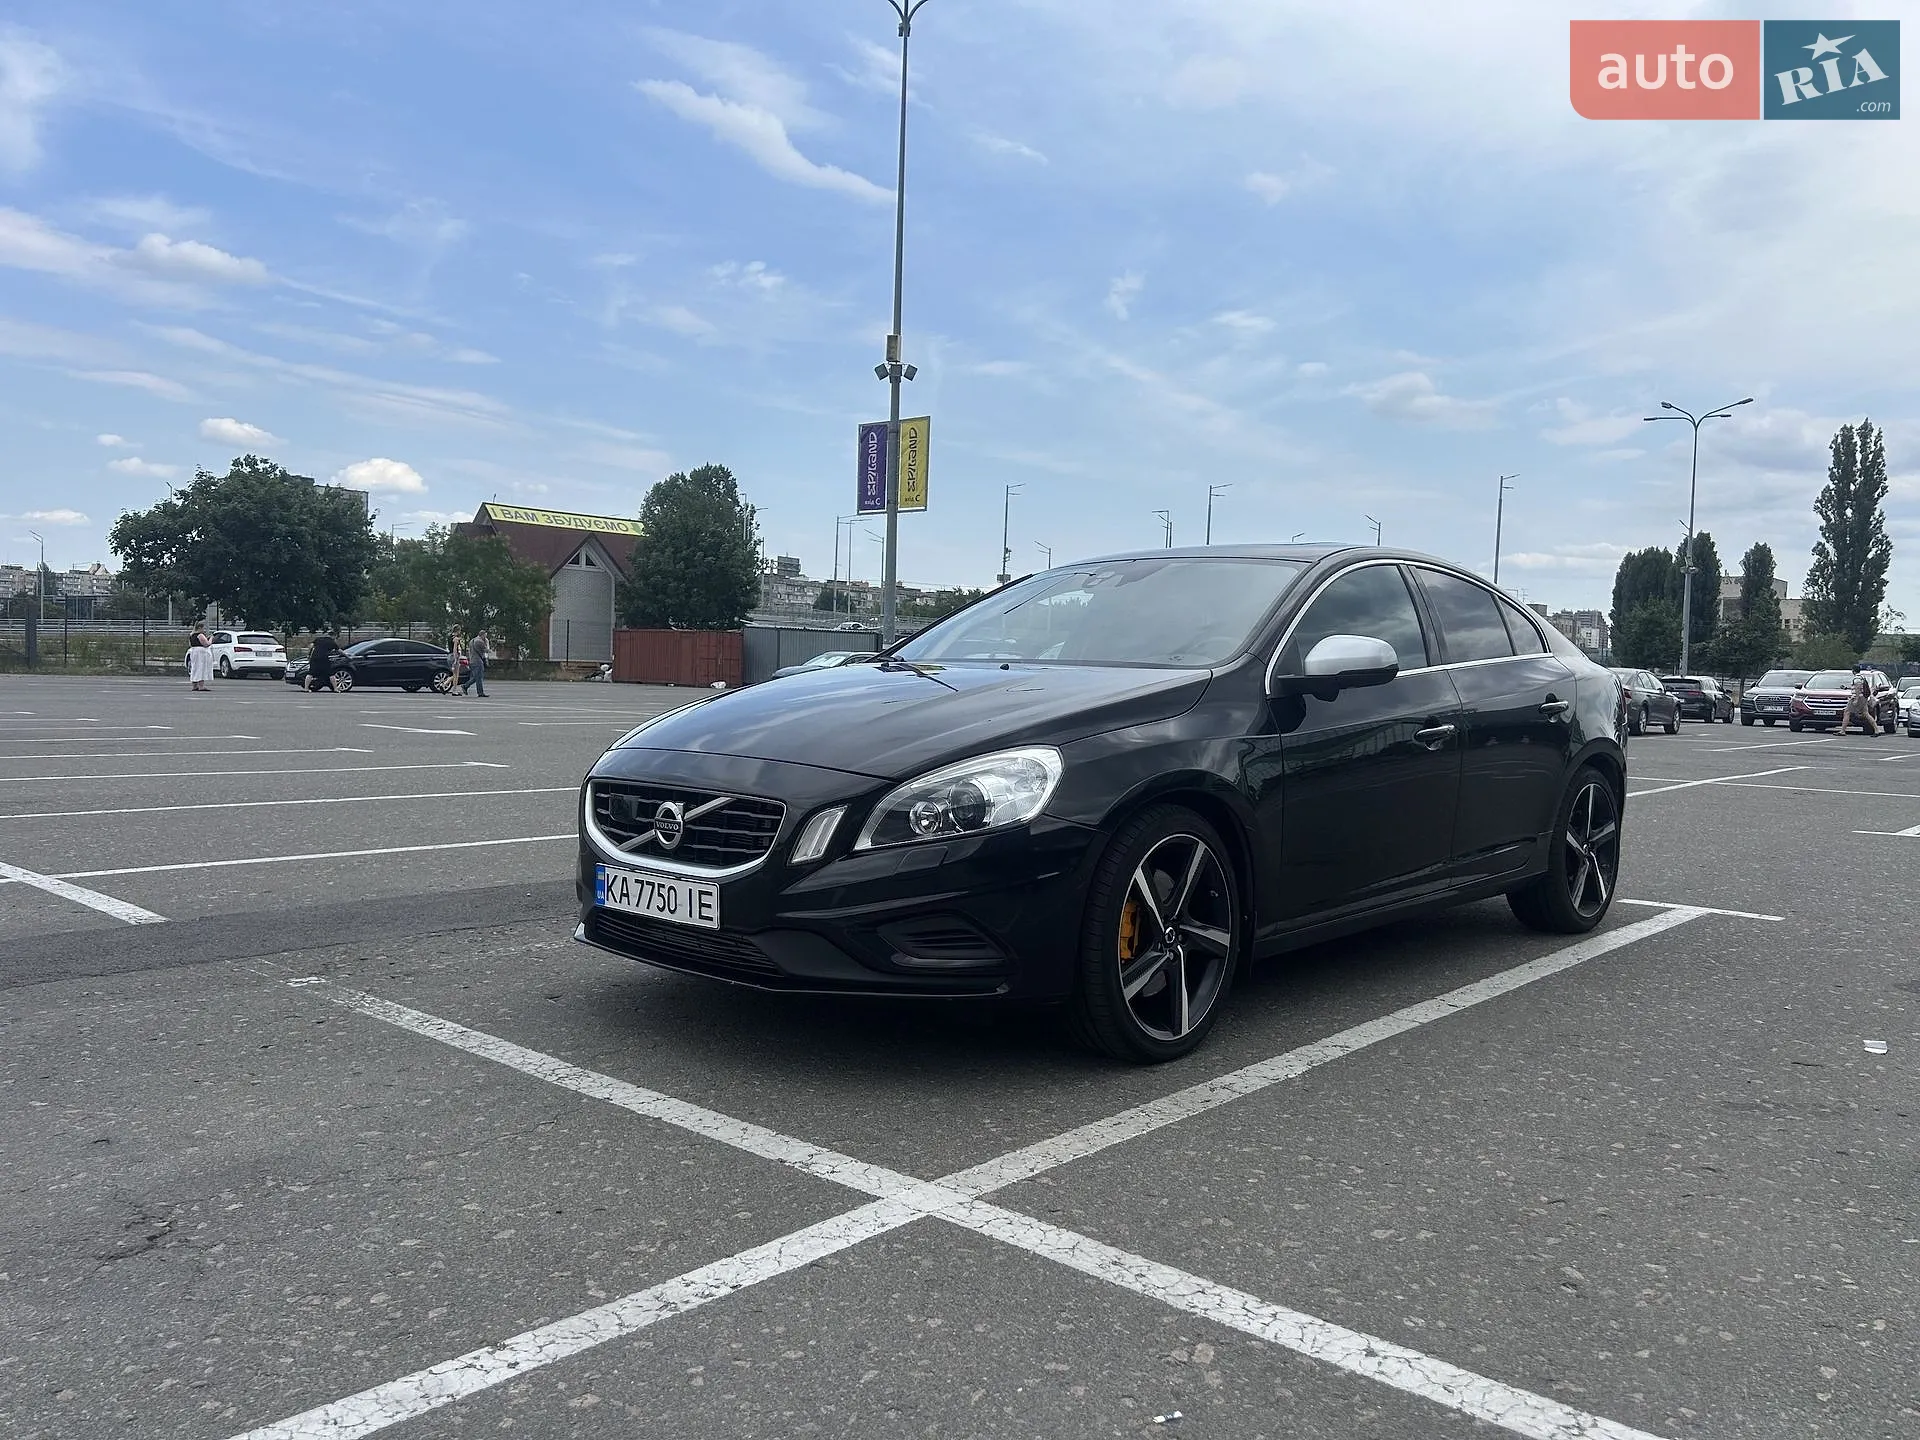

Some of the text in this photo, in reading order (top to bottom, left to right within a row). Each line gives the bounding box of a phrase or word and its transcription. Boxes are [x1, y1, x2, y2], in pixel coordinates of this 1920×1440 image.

[501, 508, 539, 522] ВАМ
[544, 514, 629, 533] ЗБУДУЄМО
[655, 821, 679, 831] VOLVO
[688, 888, 714, 922] IE
